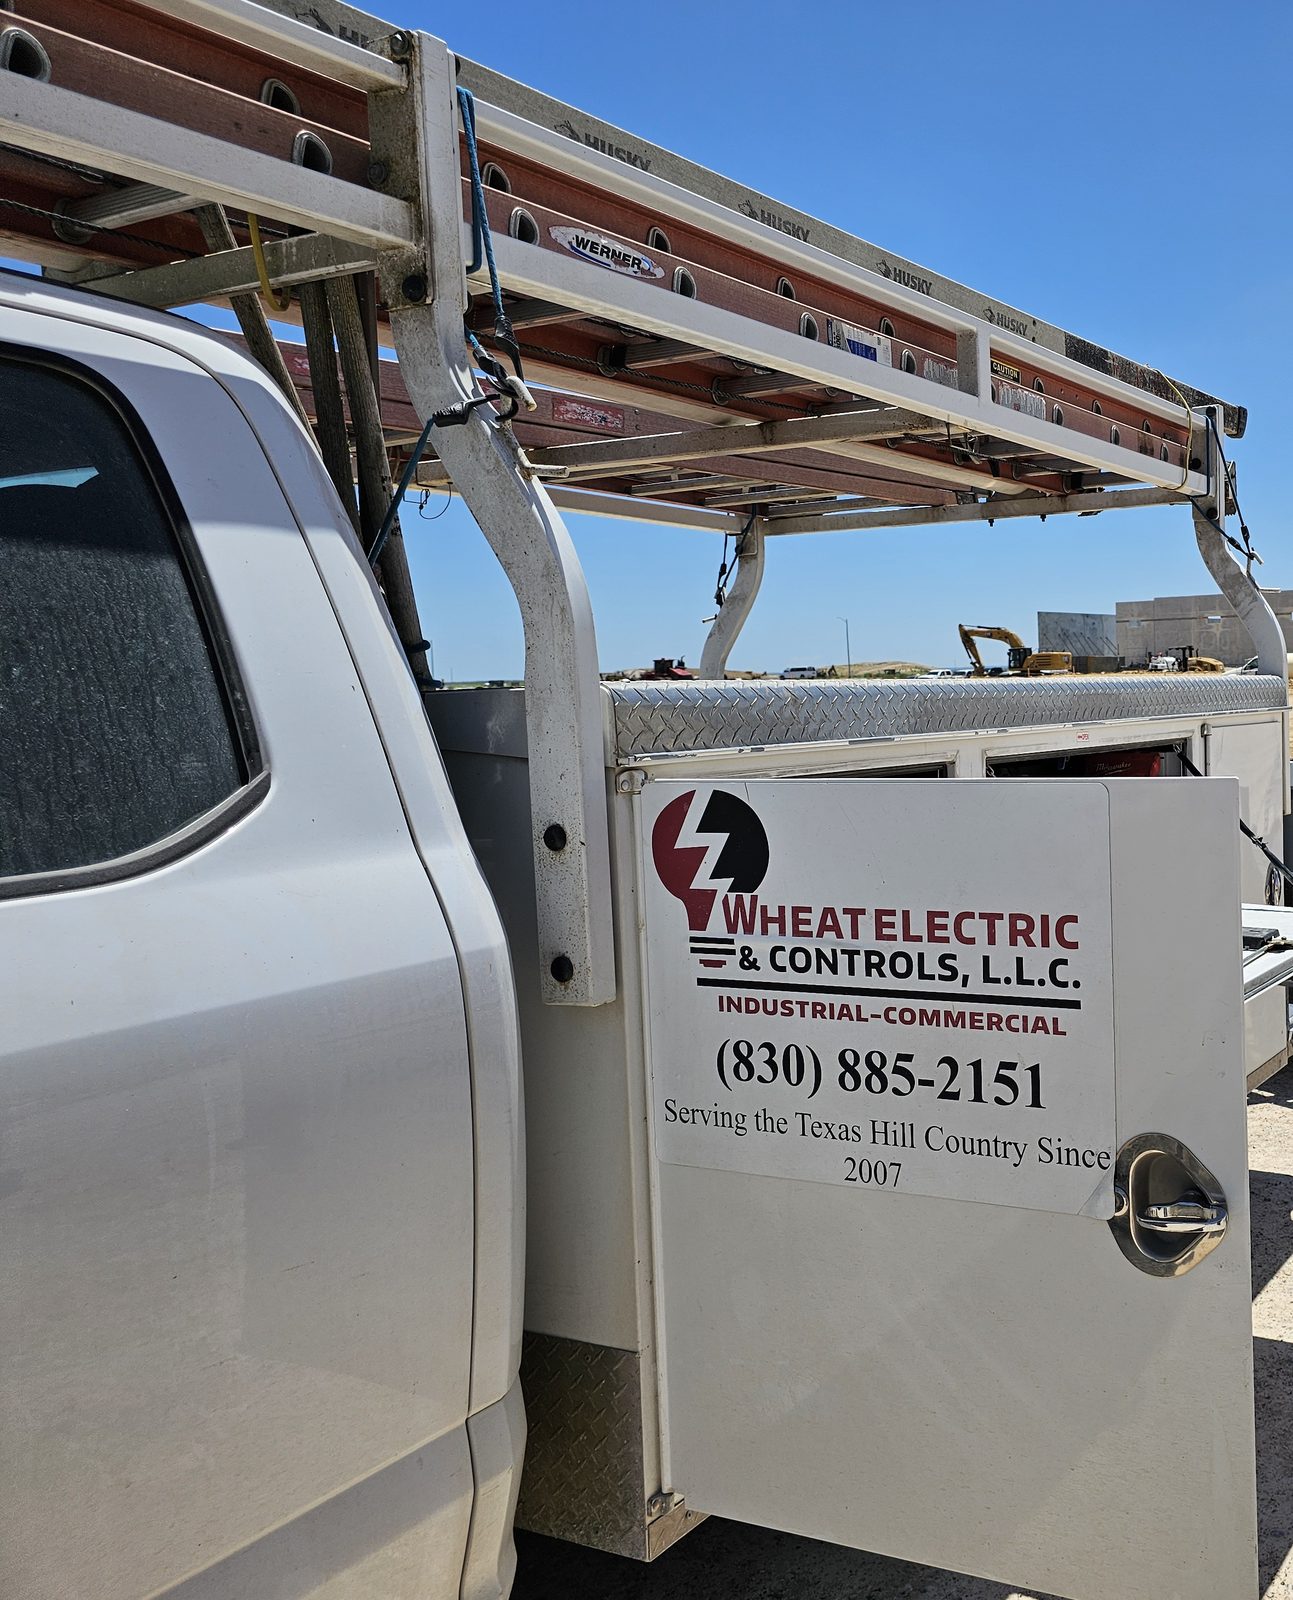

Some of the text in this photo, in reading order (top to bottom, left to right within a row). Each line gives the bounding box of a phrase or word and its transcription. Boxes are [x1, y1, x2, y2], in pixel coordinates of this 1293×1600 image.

[585, 132, 652, 171] HUSKY
[760, 208, 811, 243] HUSKY
[573, 234, 642, 271] WERNER
[893, 267, 933, 296] HUSKY
[996, 312, 1028, 337] HUSKY
[992, 362, 1019, 380] CAUTION
[739, 945, 1081, 990] & CONTROLS, L.L.C.
[718, 994, 1067, 1037] INDUSTRIAL-COMMERCIAL
[716, 1038, 1047, 1110] (830) 885-2151
[664, 1098, 1111, 1171] Serving the Texas Hill Country Since
[843, 1156, 902, 1188] 2007
